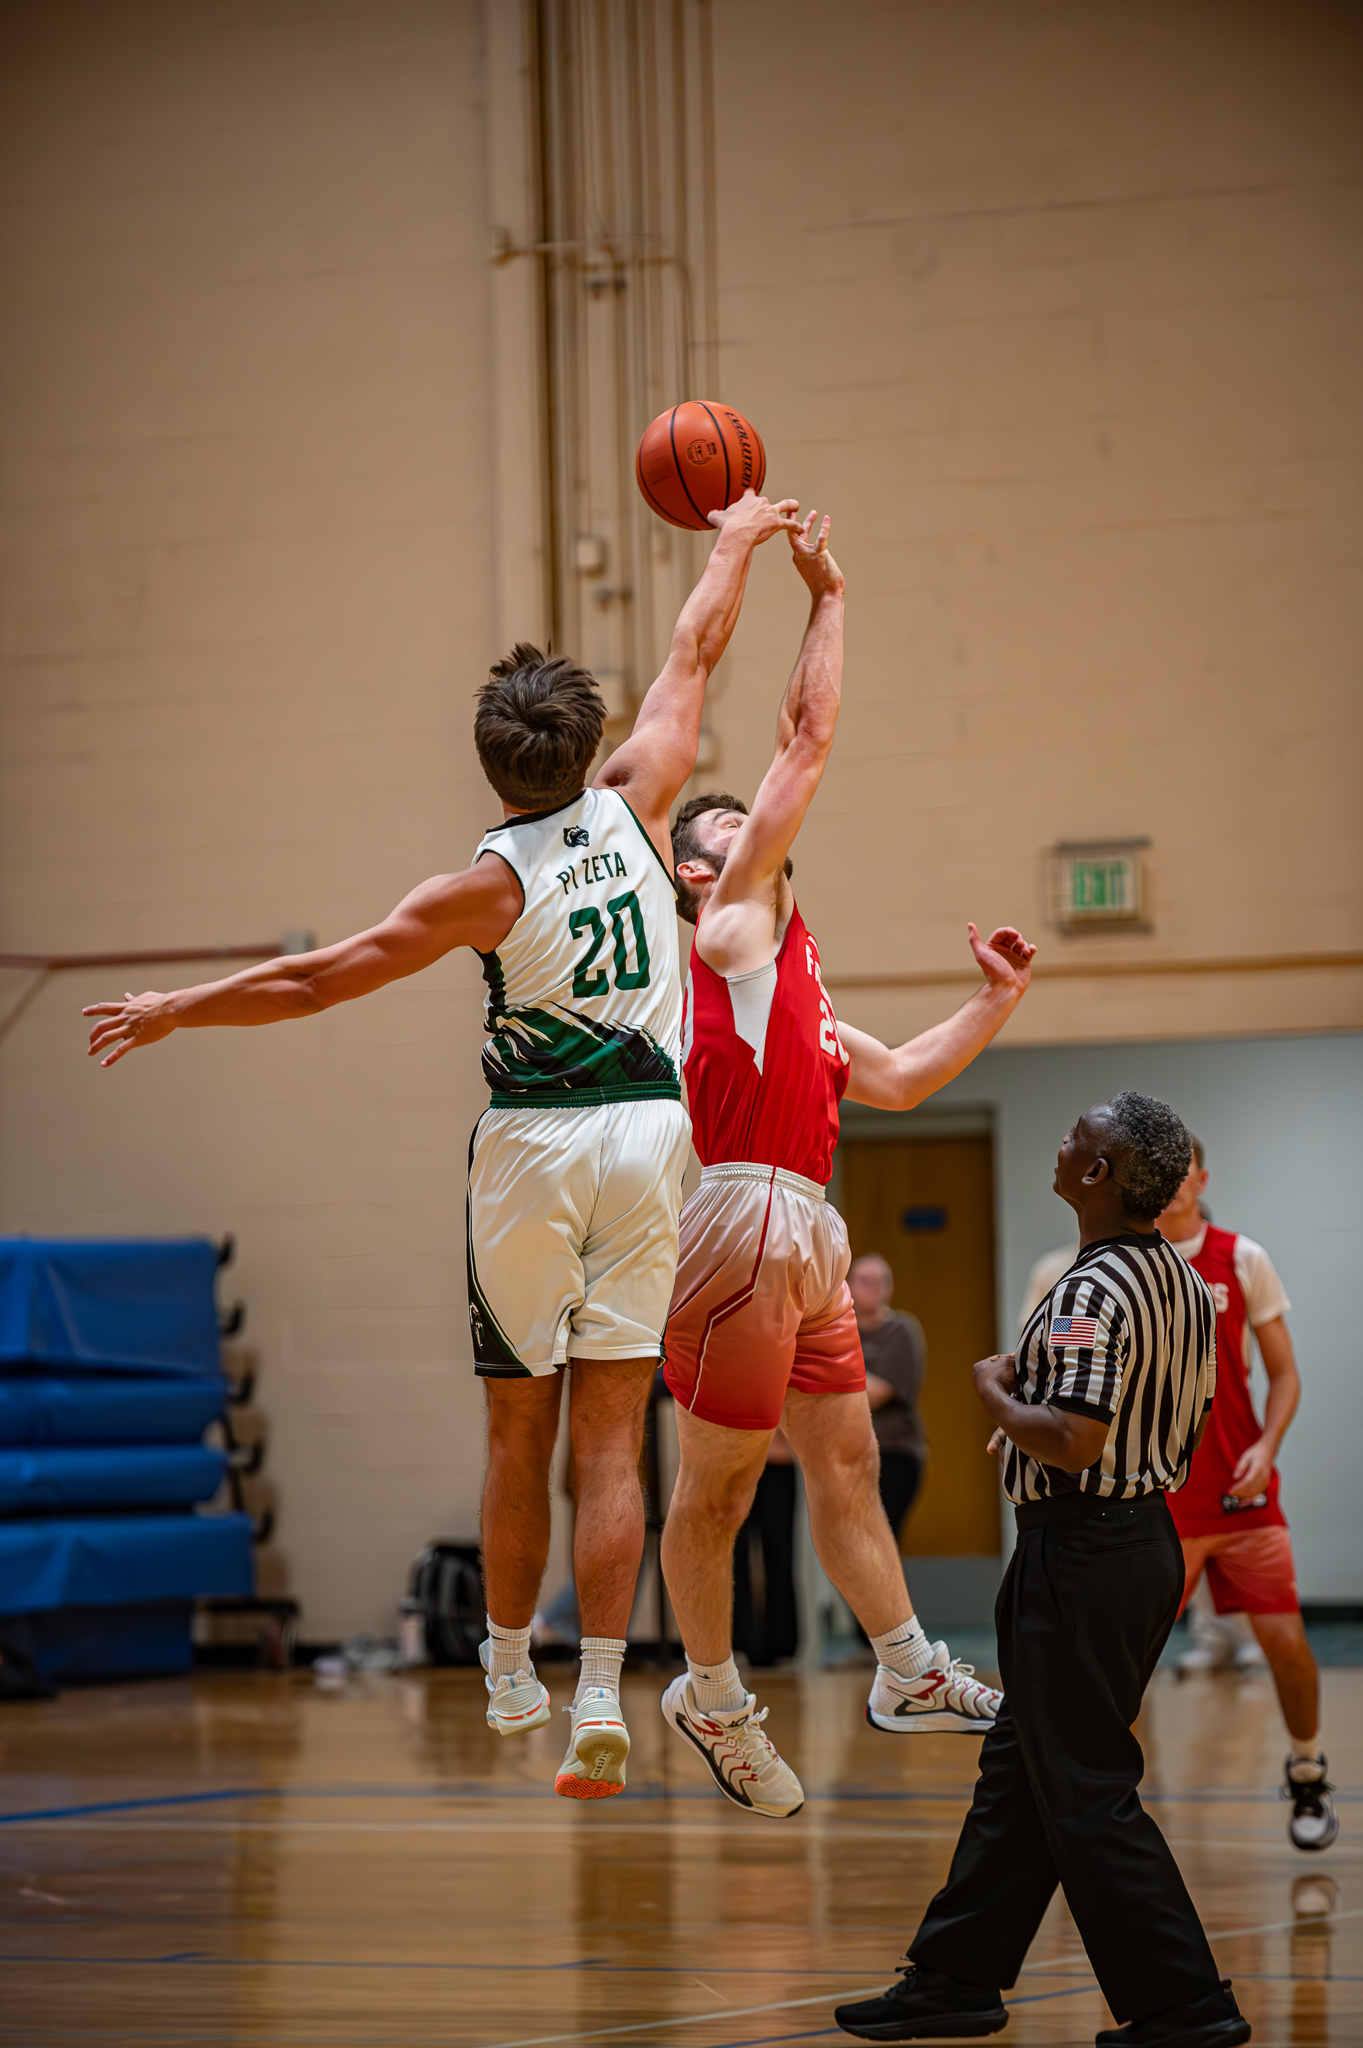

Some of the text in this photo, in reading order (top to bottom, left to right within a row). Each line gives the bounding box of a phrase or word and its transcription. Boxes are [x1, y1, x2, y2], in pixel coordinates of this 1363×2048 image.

[556, 851, 628, 895] PI ZETA
[569, 889, 651, 998] 20
